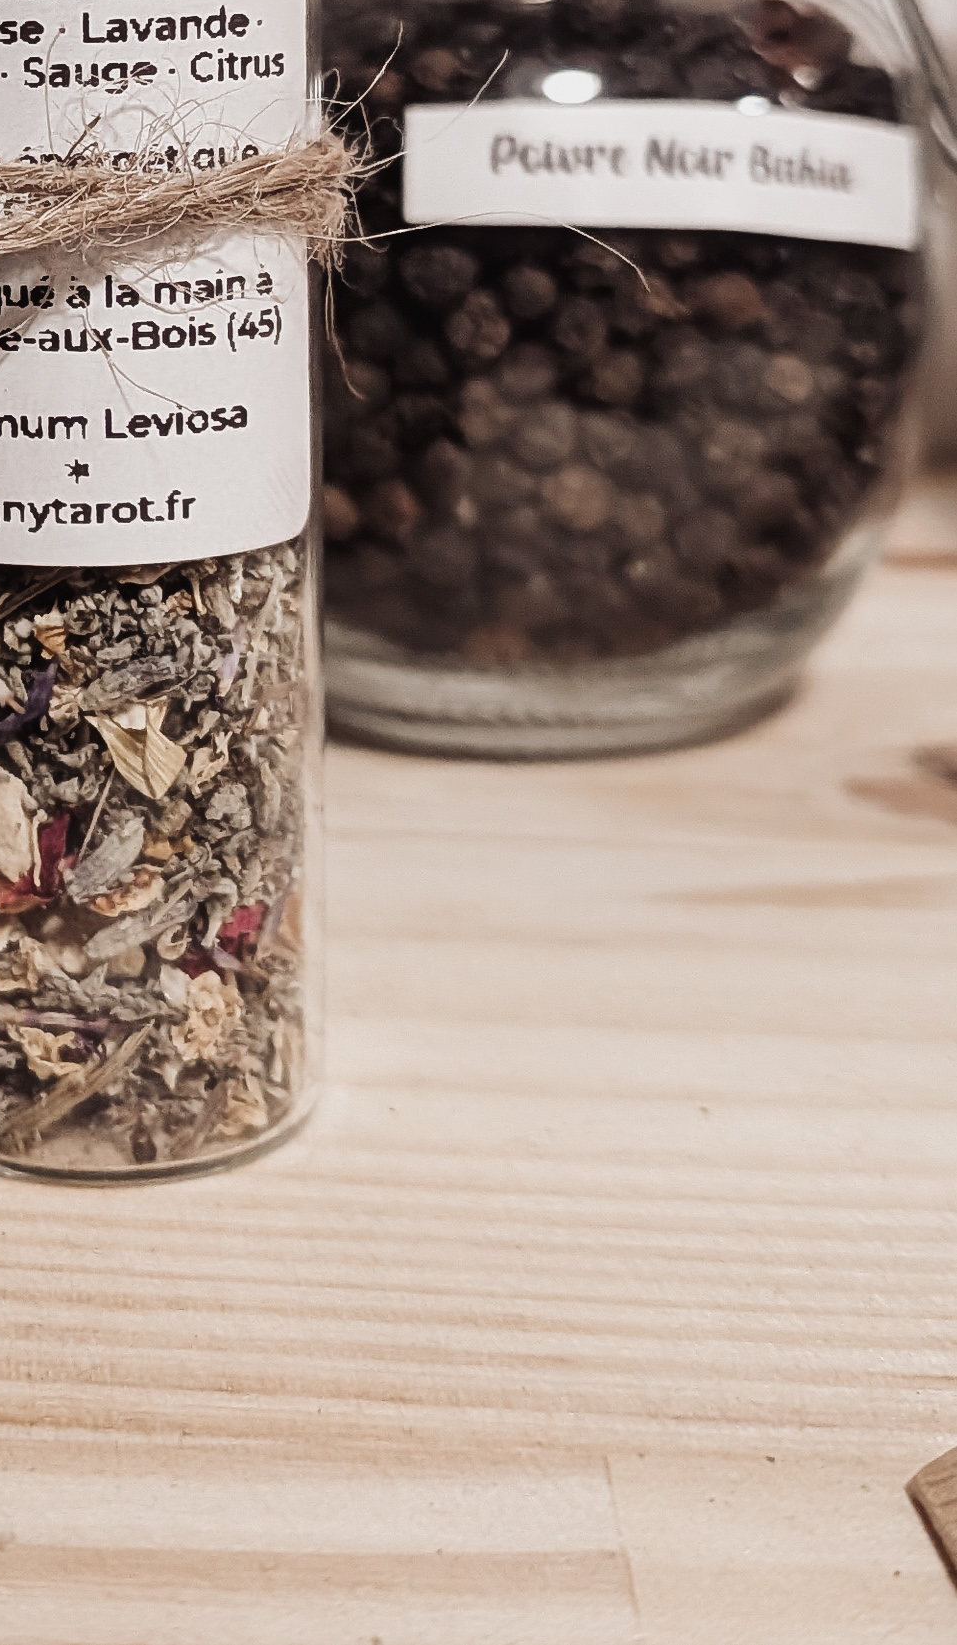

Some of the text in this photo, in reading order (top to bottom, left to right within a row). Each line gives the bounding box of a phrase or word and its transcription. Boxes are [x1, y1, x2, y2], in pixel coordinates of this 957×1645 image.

[23, 56, 158, 95] Sauge
[190, 48, 284, 83] Citrus
[491, 133, 628, 177] Poivre
[646, 135, 734, 179] Noir
[66, 275, 91, 309] à
[105, 274, 140, 308] la
[154, 268, 246, 305] main
[227, 304, 282, 353] (45)
[104, 404, 248, 440] Leviosa
